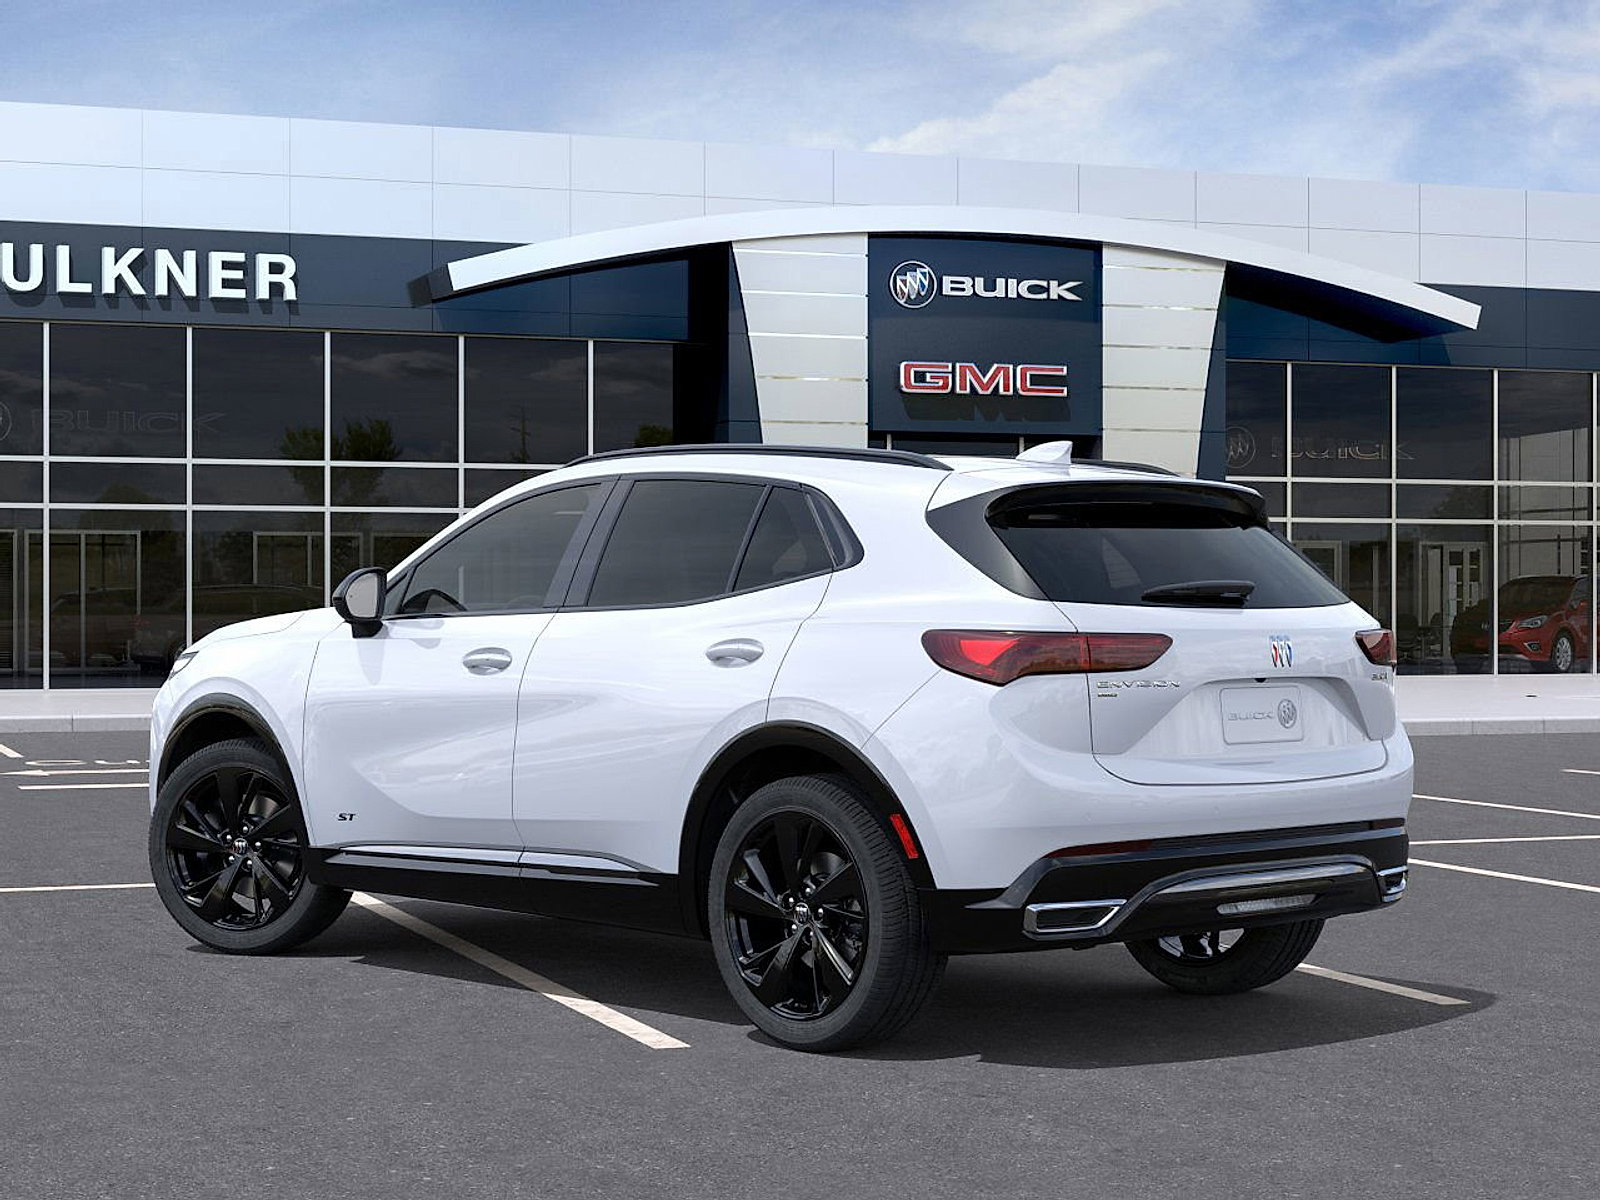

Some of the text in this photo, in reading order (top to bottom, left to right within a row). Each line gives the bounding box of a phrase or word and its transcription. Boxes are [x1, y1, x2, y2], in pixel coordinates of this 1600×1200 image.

[0, 242, 298, 302] ULKNER
[942, 275, 1084, 301] BUICK
[900, 361, 1068, 397] GMC
[1227, 711, 1274, 721] BUICK
[337, 812, 356, 821] ST
